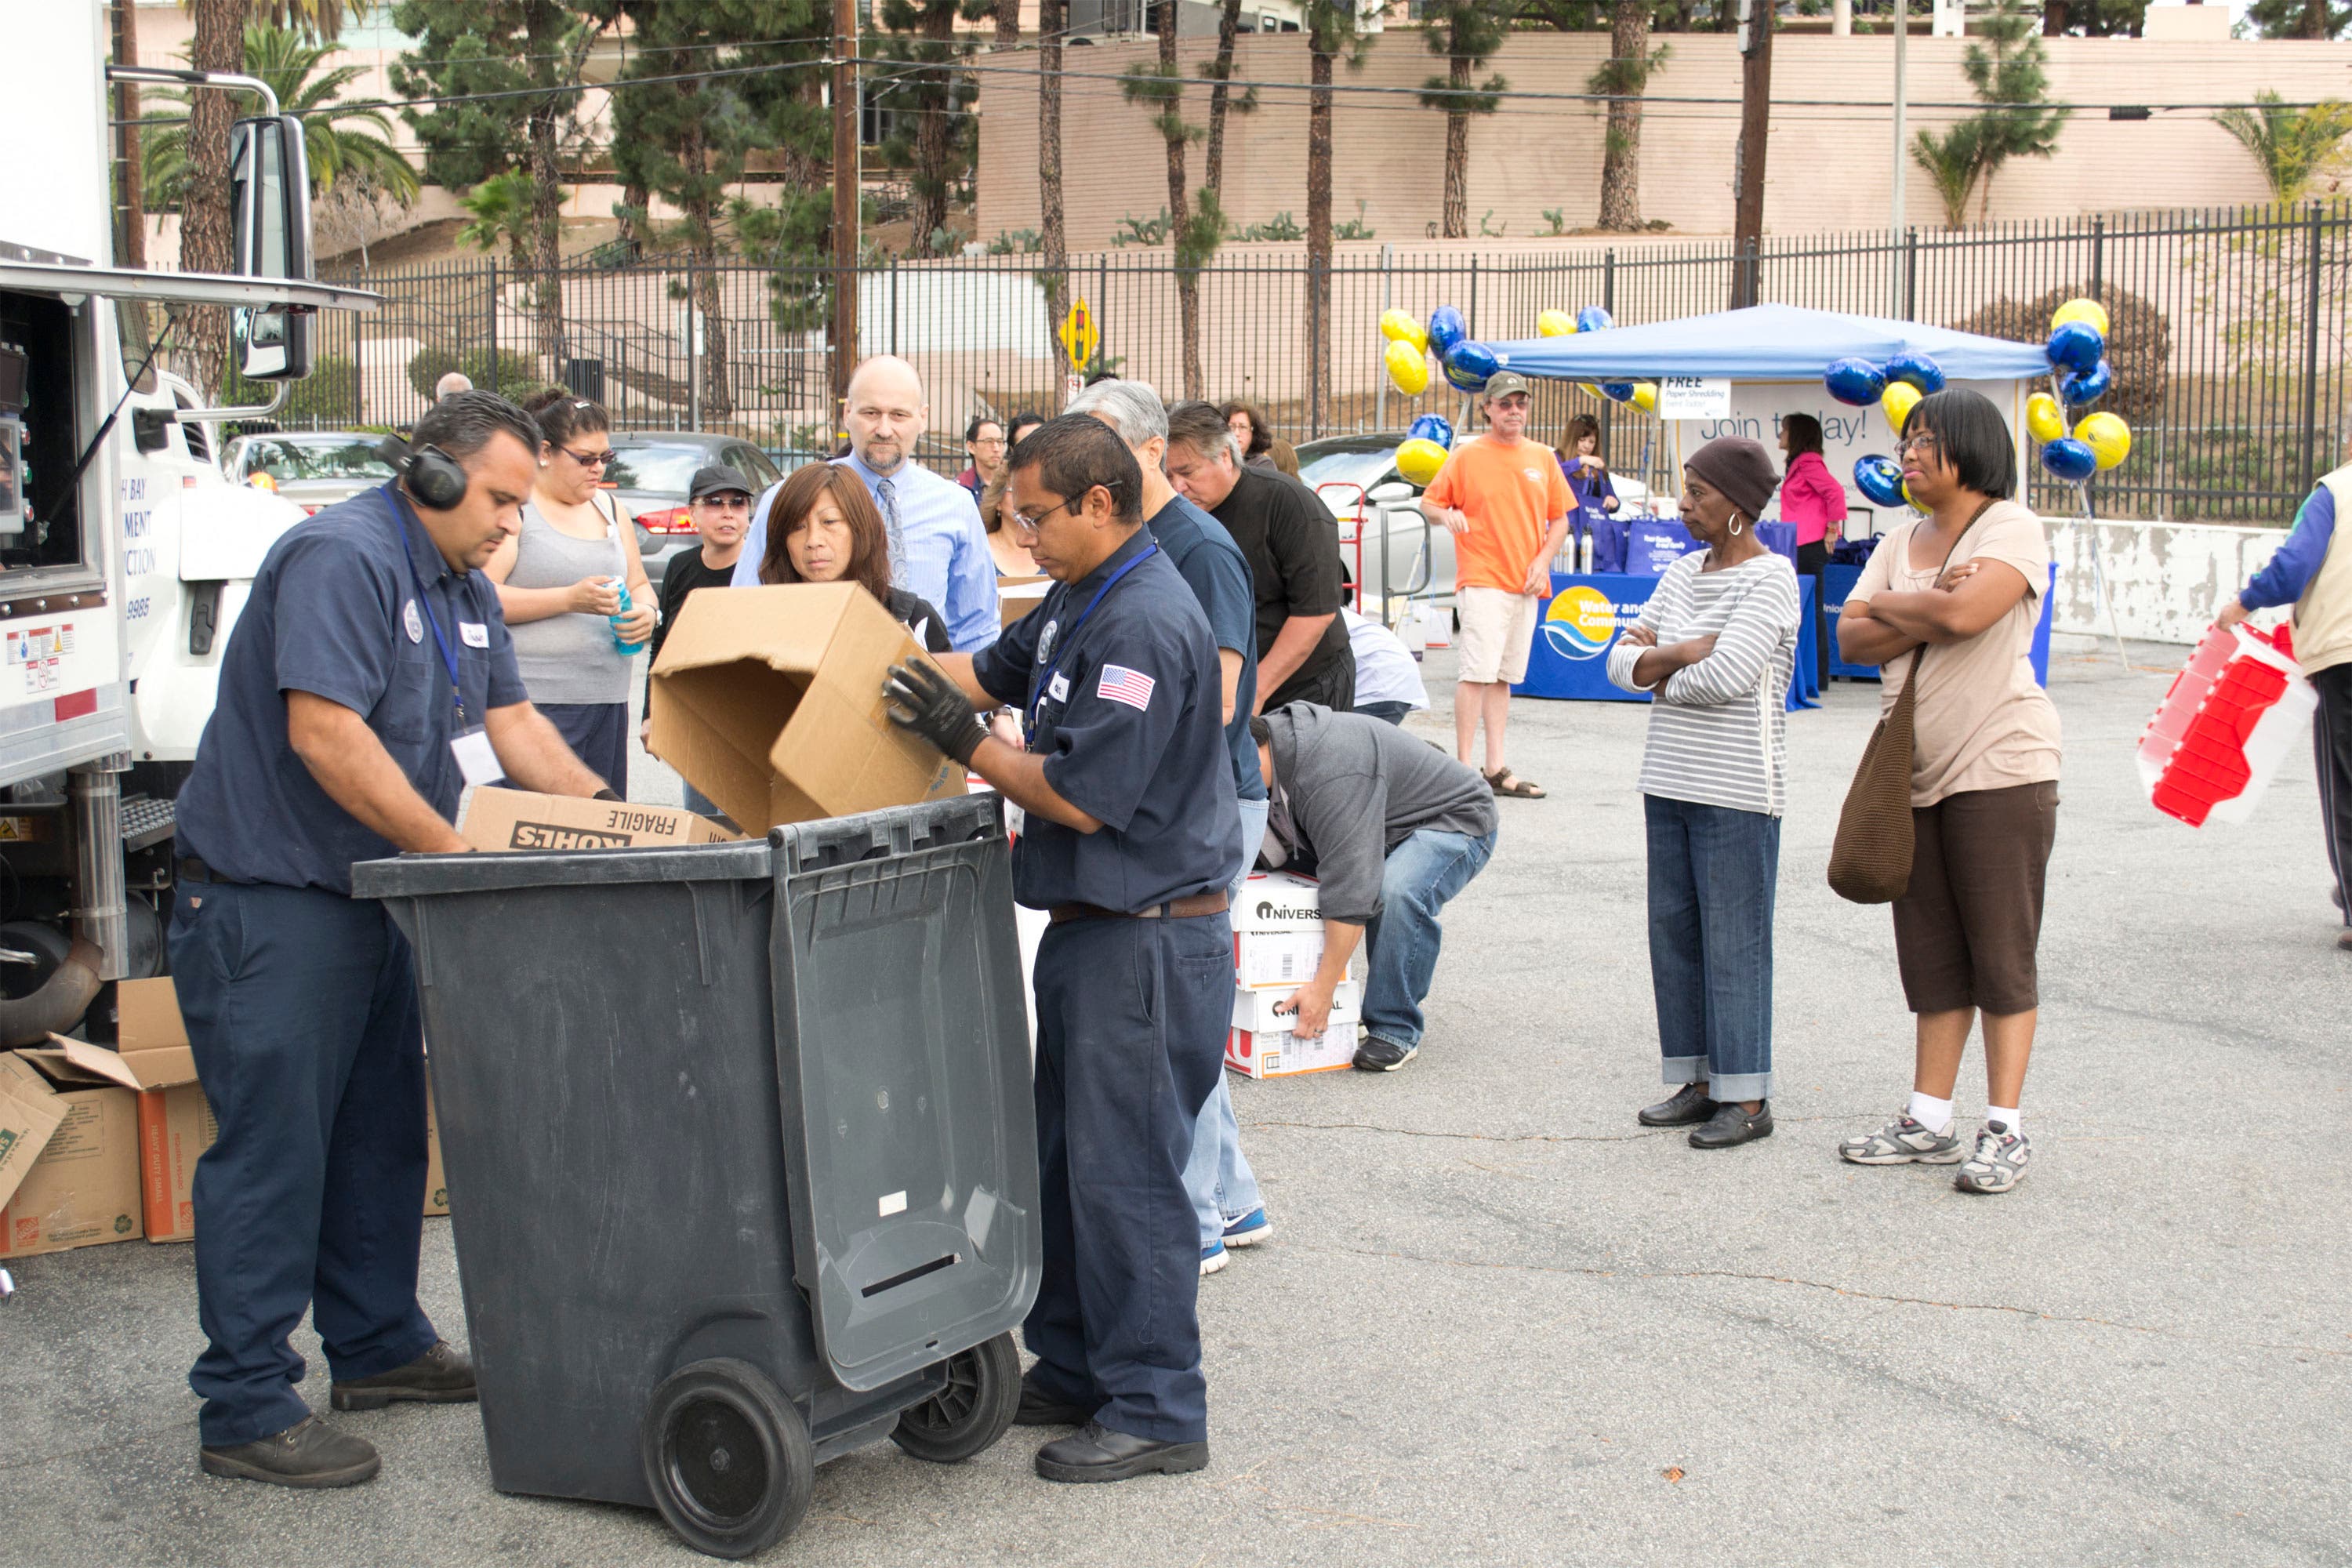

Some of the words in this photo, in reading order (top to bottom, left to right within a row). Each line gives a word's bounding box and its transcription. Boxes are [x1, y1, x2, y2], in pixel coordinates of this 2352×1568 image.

[1667, 376, 1703, 388] FREE
[1700, 411, 1761, 440] Join
[1772, 409, 1867, 447] tay!
[130, 477, 147, 500] BAY
[126, 597, 151, 620] 9985
[1579, 600, 1621, 614] Water
[606, 810, 677, 836] FRAGILE
[1256, 901, 1323, 920] UNIVERS
[151, 1124, 160, 1152] HEAVY
[154, 1153, 163, 1175] DUTY
